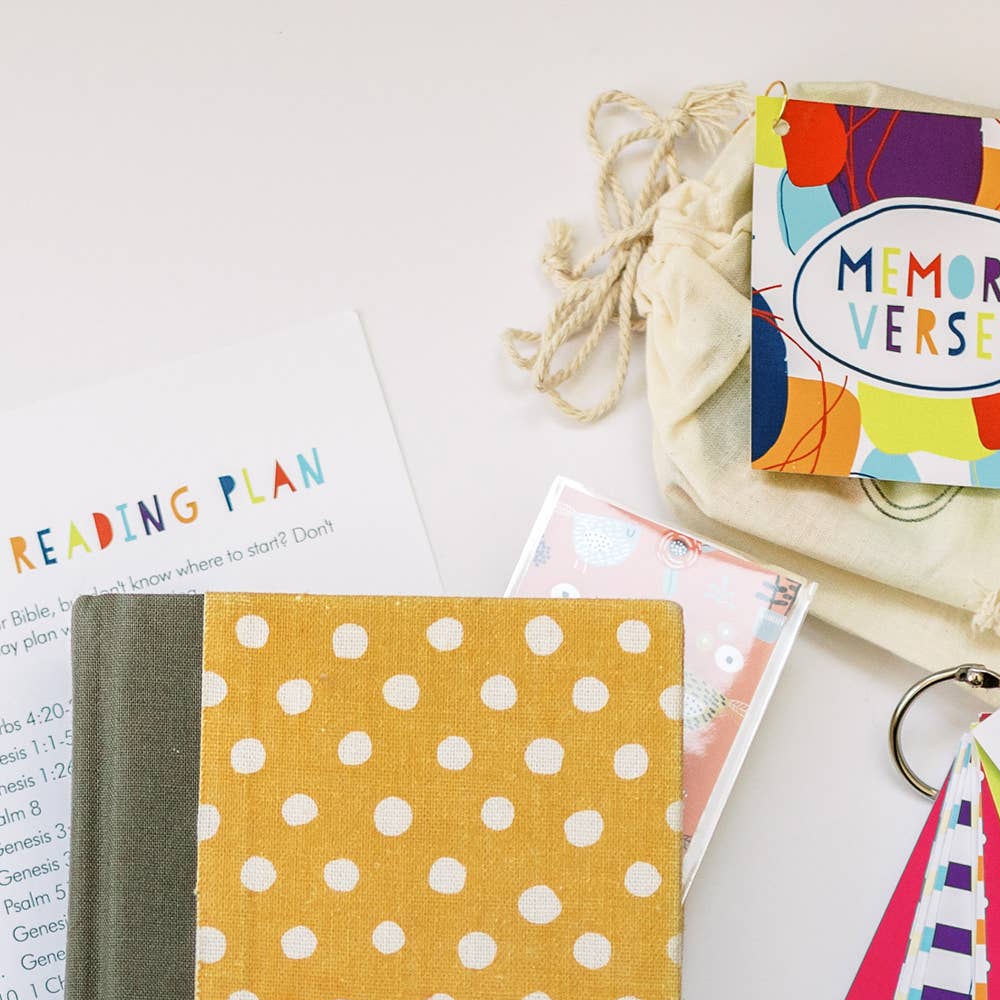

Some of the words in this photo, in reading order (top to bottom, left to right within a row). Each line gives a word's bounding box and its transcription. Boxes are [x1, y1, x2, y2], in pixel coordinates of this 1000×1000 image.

[9, 485, 198, 574] READING
[218, 447, 325, 512] PLAN
[10, 602, 56, 627] Bible,
[129, 575, 173, 591] know
[176, 555, 224, 577] where
[227, 549, 244, 563] to
[247, 531, 288, 558] start?
[292, 519, 336, 544] Don't
[23, 630, 58, 653] plan
[30, 800, 42, 817] 8
[0, 858, 60, 886] Genesis
[4, 891, 51, 915] Psalm
